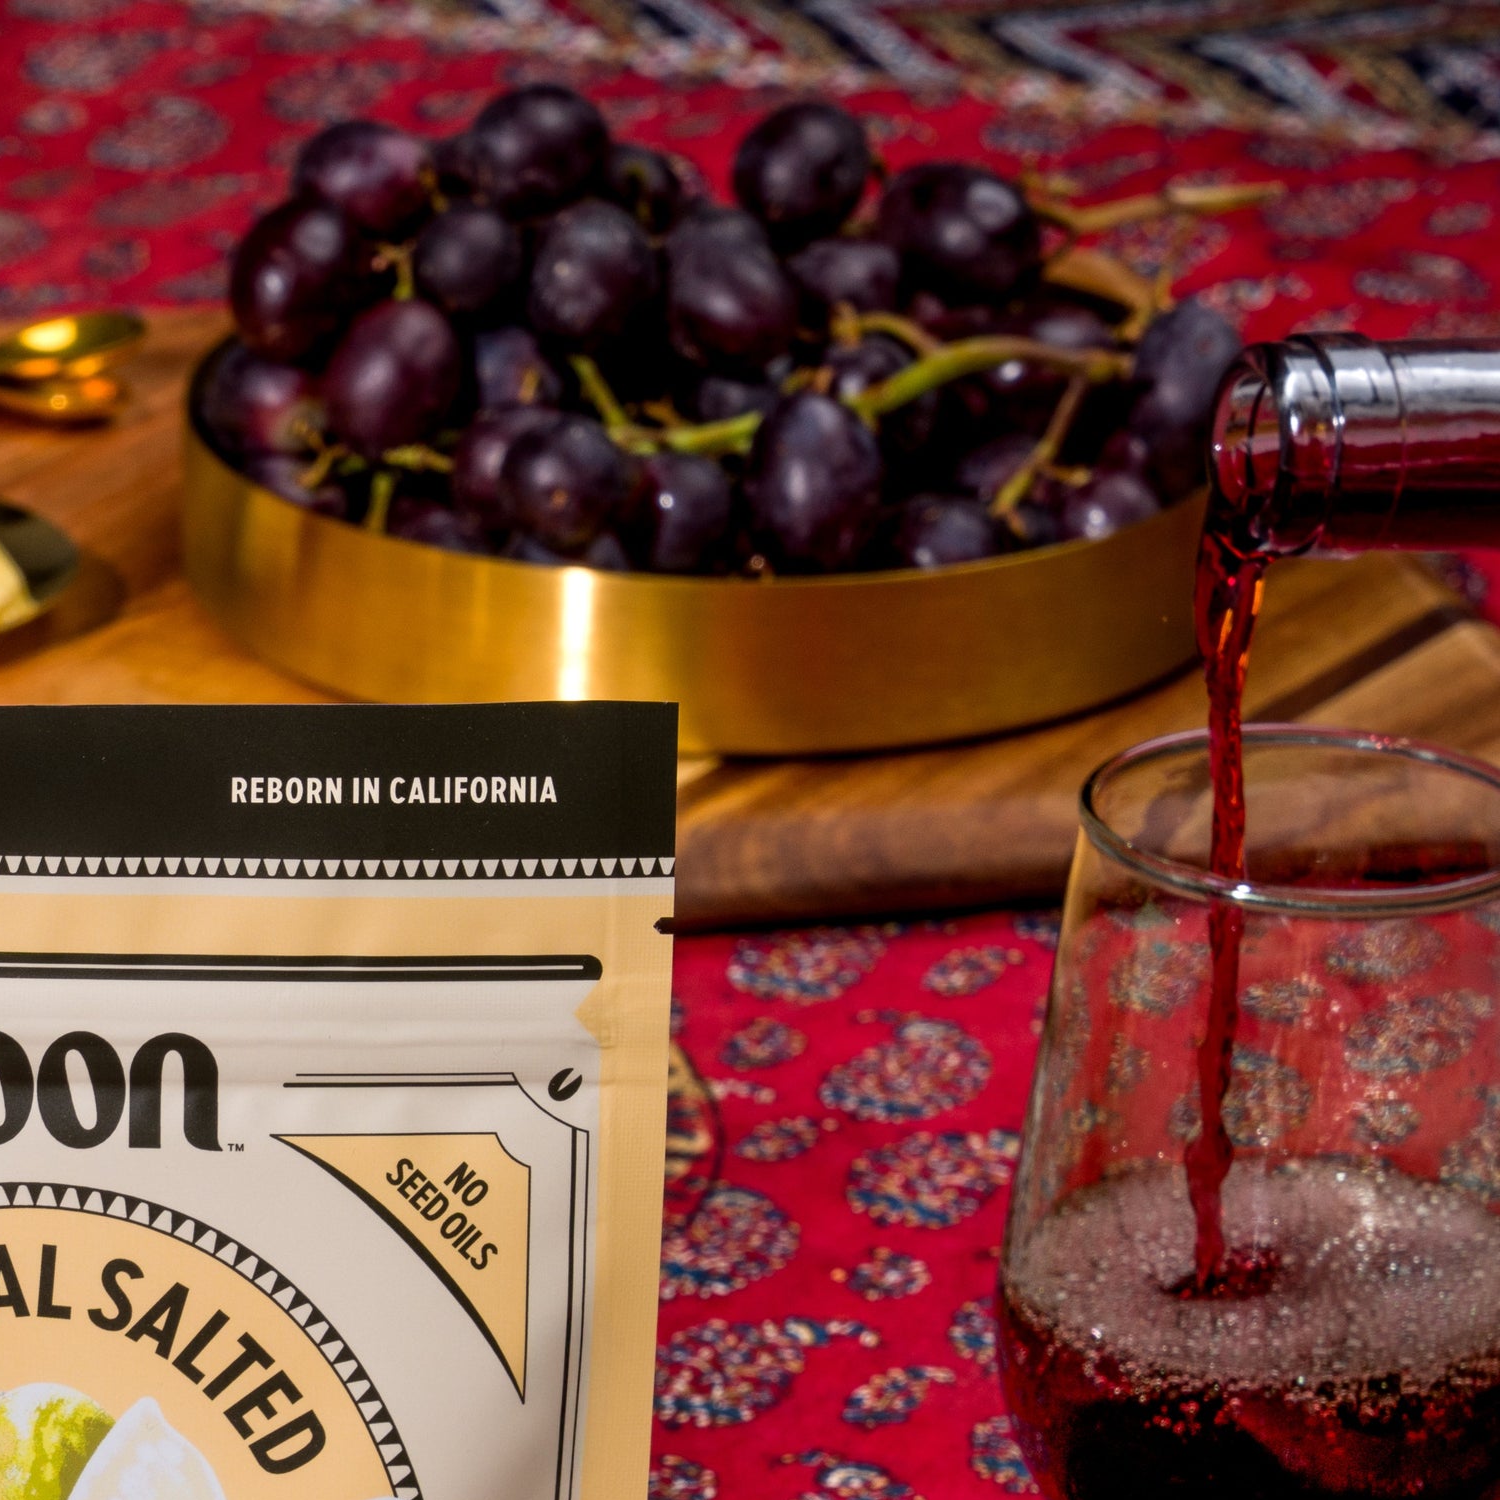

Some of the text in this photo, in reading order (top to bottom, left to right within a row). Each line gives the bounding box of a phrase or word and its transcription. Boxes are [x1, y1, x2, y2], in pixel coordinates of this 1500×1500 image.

[232, 777, 557, 803] REBORN IN CALIFORNIA
[386, 1159, 497, 1270] SEED OILS
[444, 1162, 488, 1205] NO
[88, 1259, 326, 1474] SALTED
